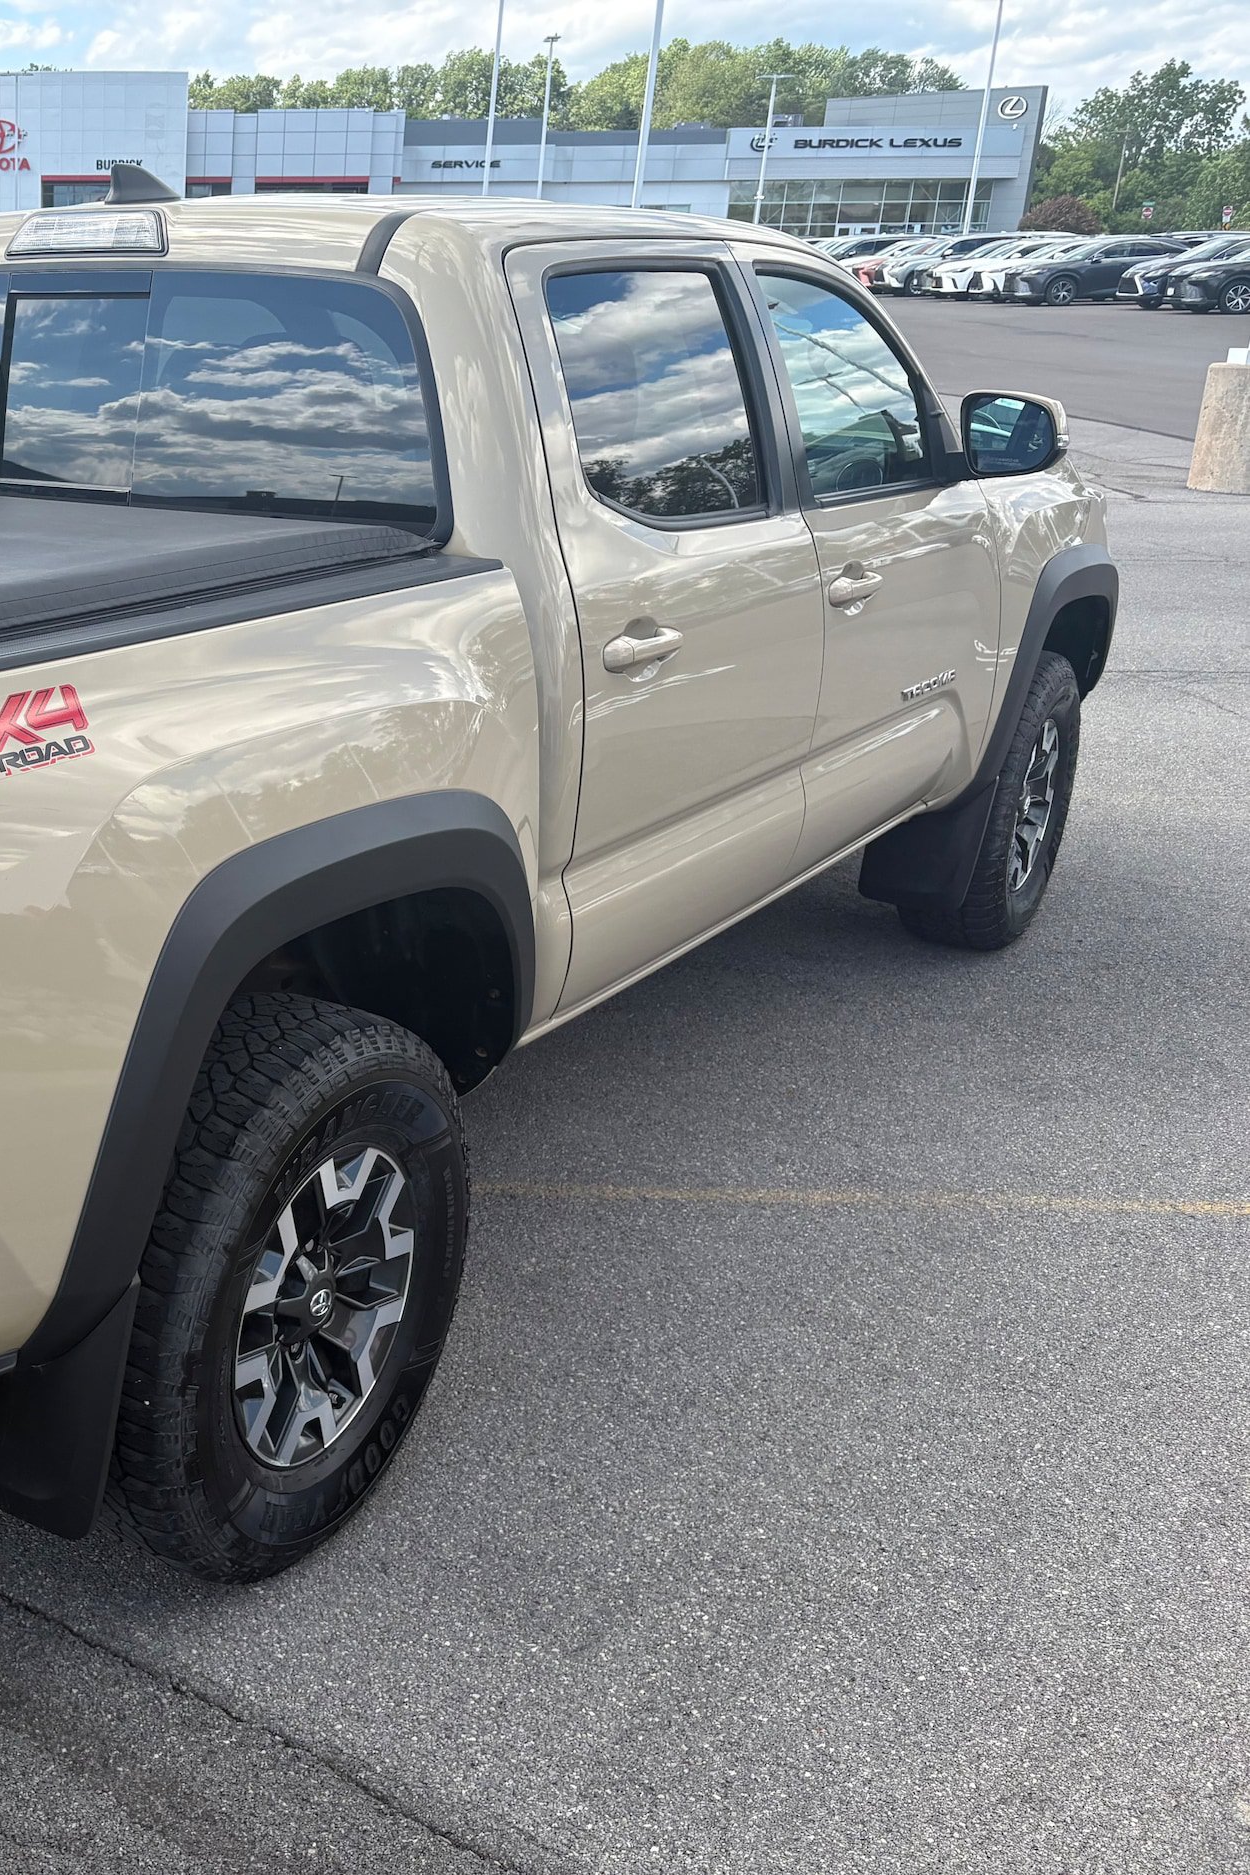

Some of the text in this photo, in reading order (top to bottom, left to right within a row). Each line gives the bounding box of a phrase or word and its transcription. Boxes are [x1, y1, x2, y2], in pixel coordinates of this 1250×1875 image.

[793, 137, 962, 149] BURDICK LEXUS
[431, 160, 501, 169] SERVICE
